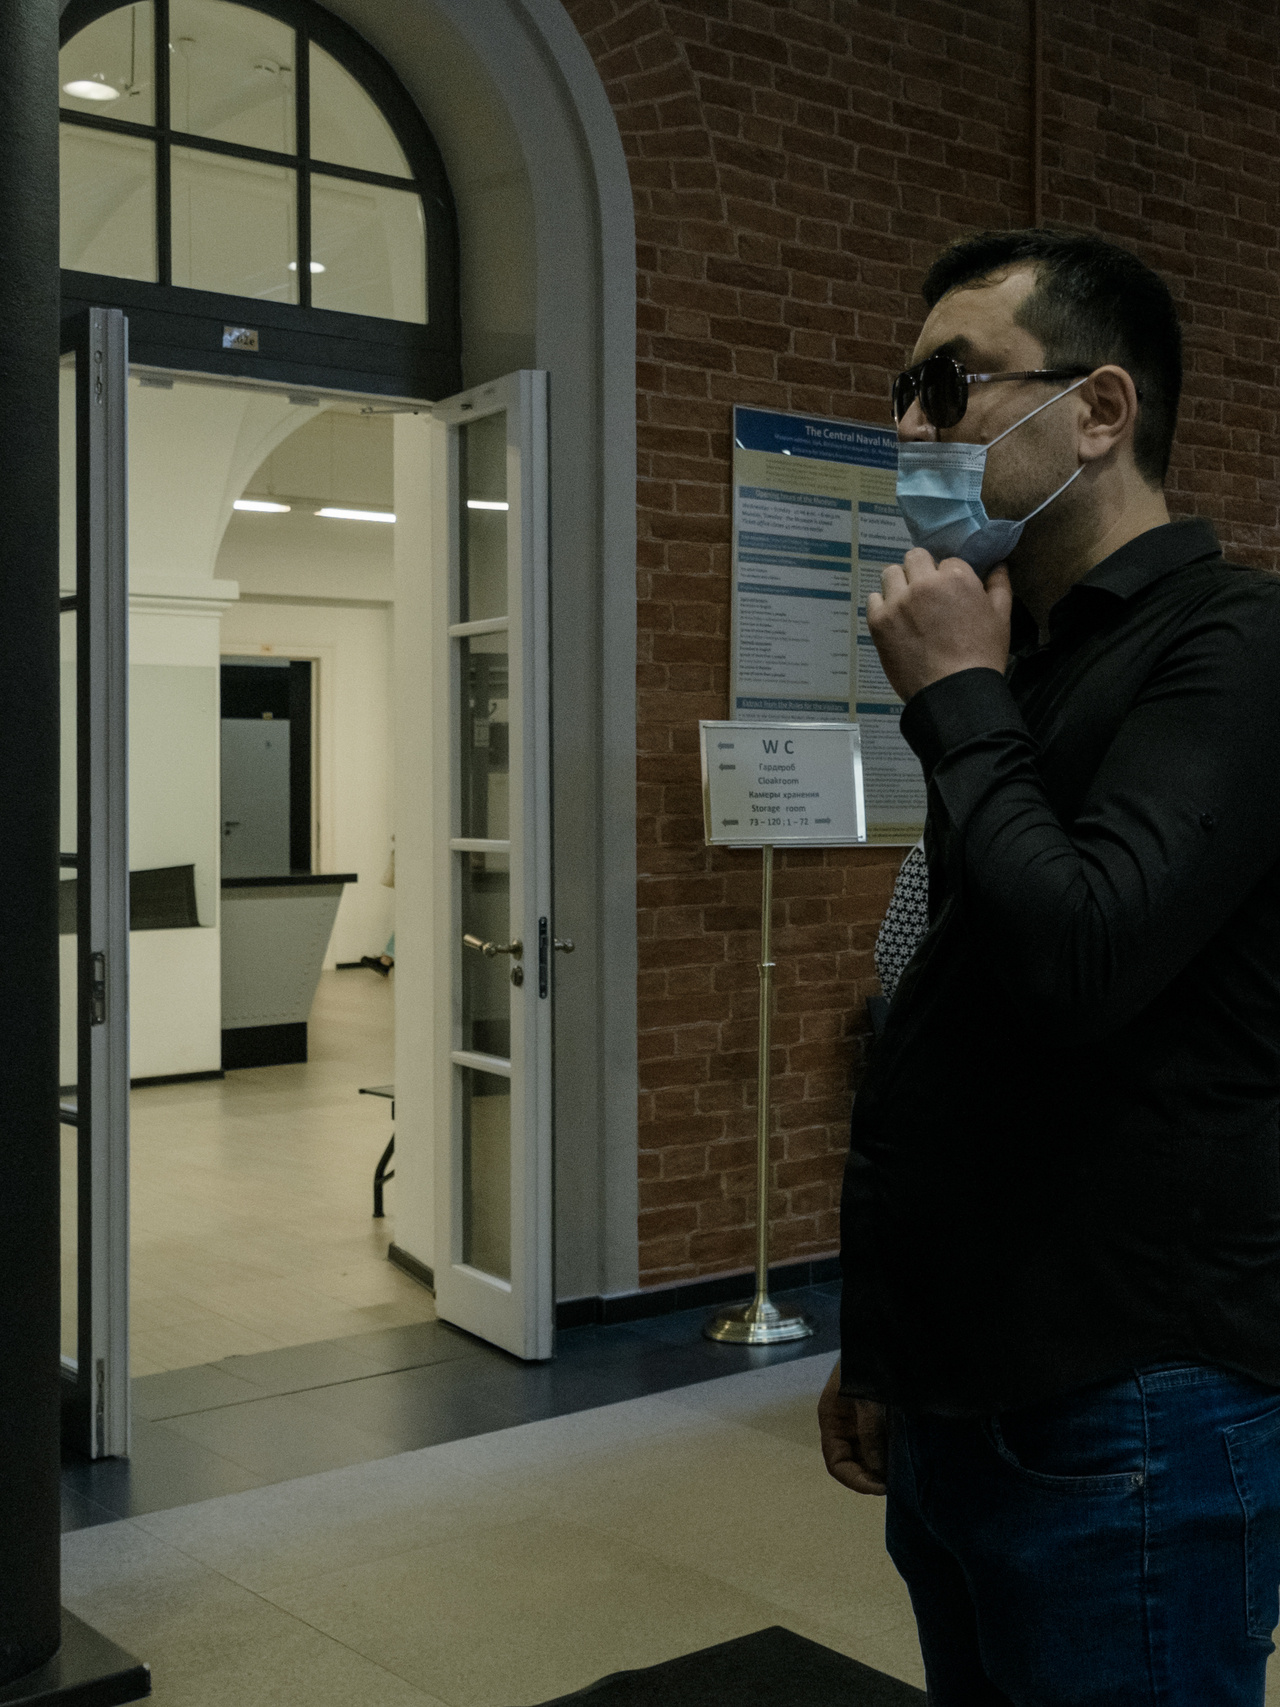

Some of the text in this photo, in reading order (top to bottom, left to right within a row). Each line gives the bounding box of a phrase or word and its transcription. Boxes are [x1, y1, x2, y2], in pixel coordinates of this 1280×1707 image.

[805, 425, 822, 438] The
[823, 428, 855, 443] Central
[856, 433, 881, 447] Naval
[882, 437, 898, 449] Mus
[759, 763, 796, 772] Гардероб
[758, 777, 799, 785] Cloakroom
[749, 791, 820, 800] Камеры хранения
[751, 804, 780, 814] Storage
[750, 818, 759, 826] 73
[800, 818, 809, 826] 72
